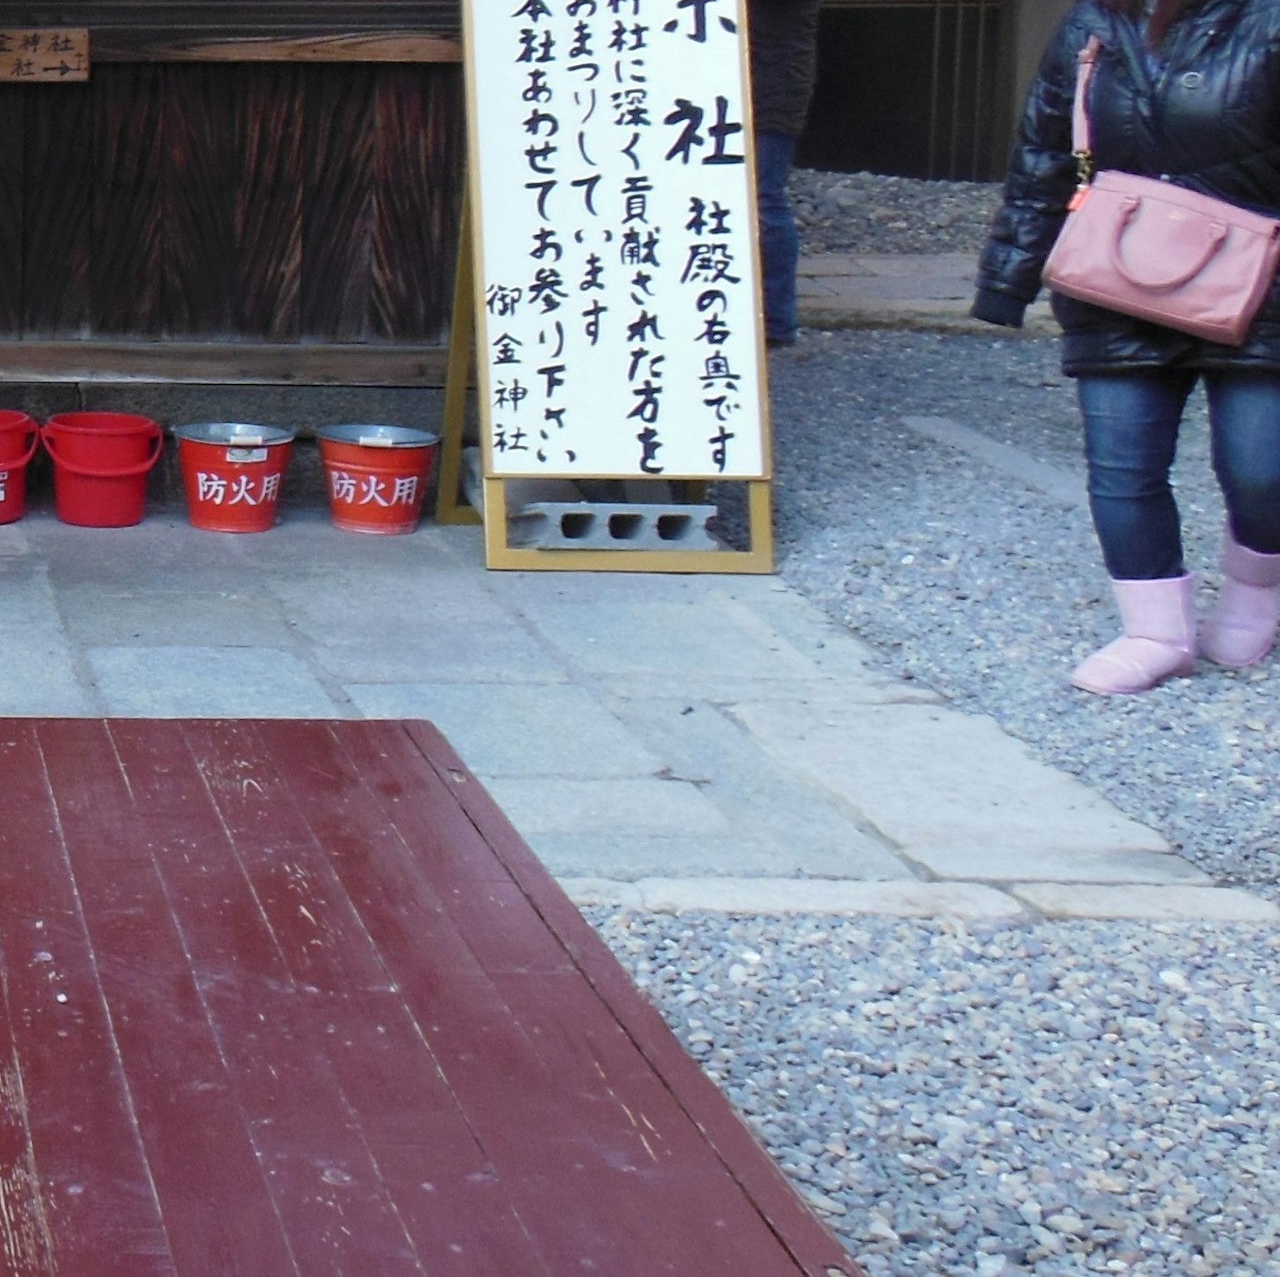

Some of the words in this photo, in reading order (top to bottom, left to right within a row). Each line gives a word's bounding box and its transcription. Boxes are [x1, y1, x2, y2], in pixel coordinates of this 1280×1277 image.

[485, 282, 530, 453] 御金神社
[680, 195, 744, 473] 社殿の右奥です
[196, 471, 282, 507] 防火用
[329, 469, 419, 508] 防火用
